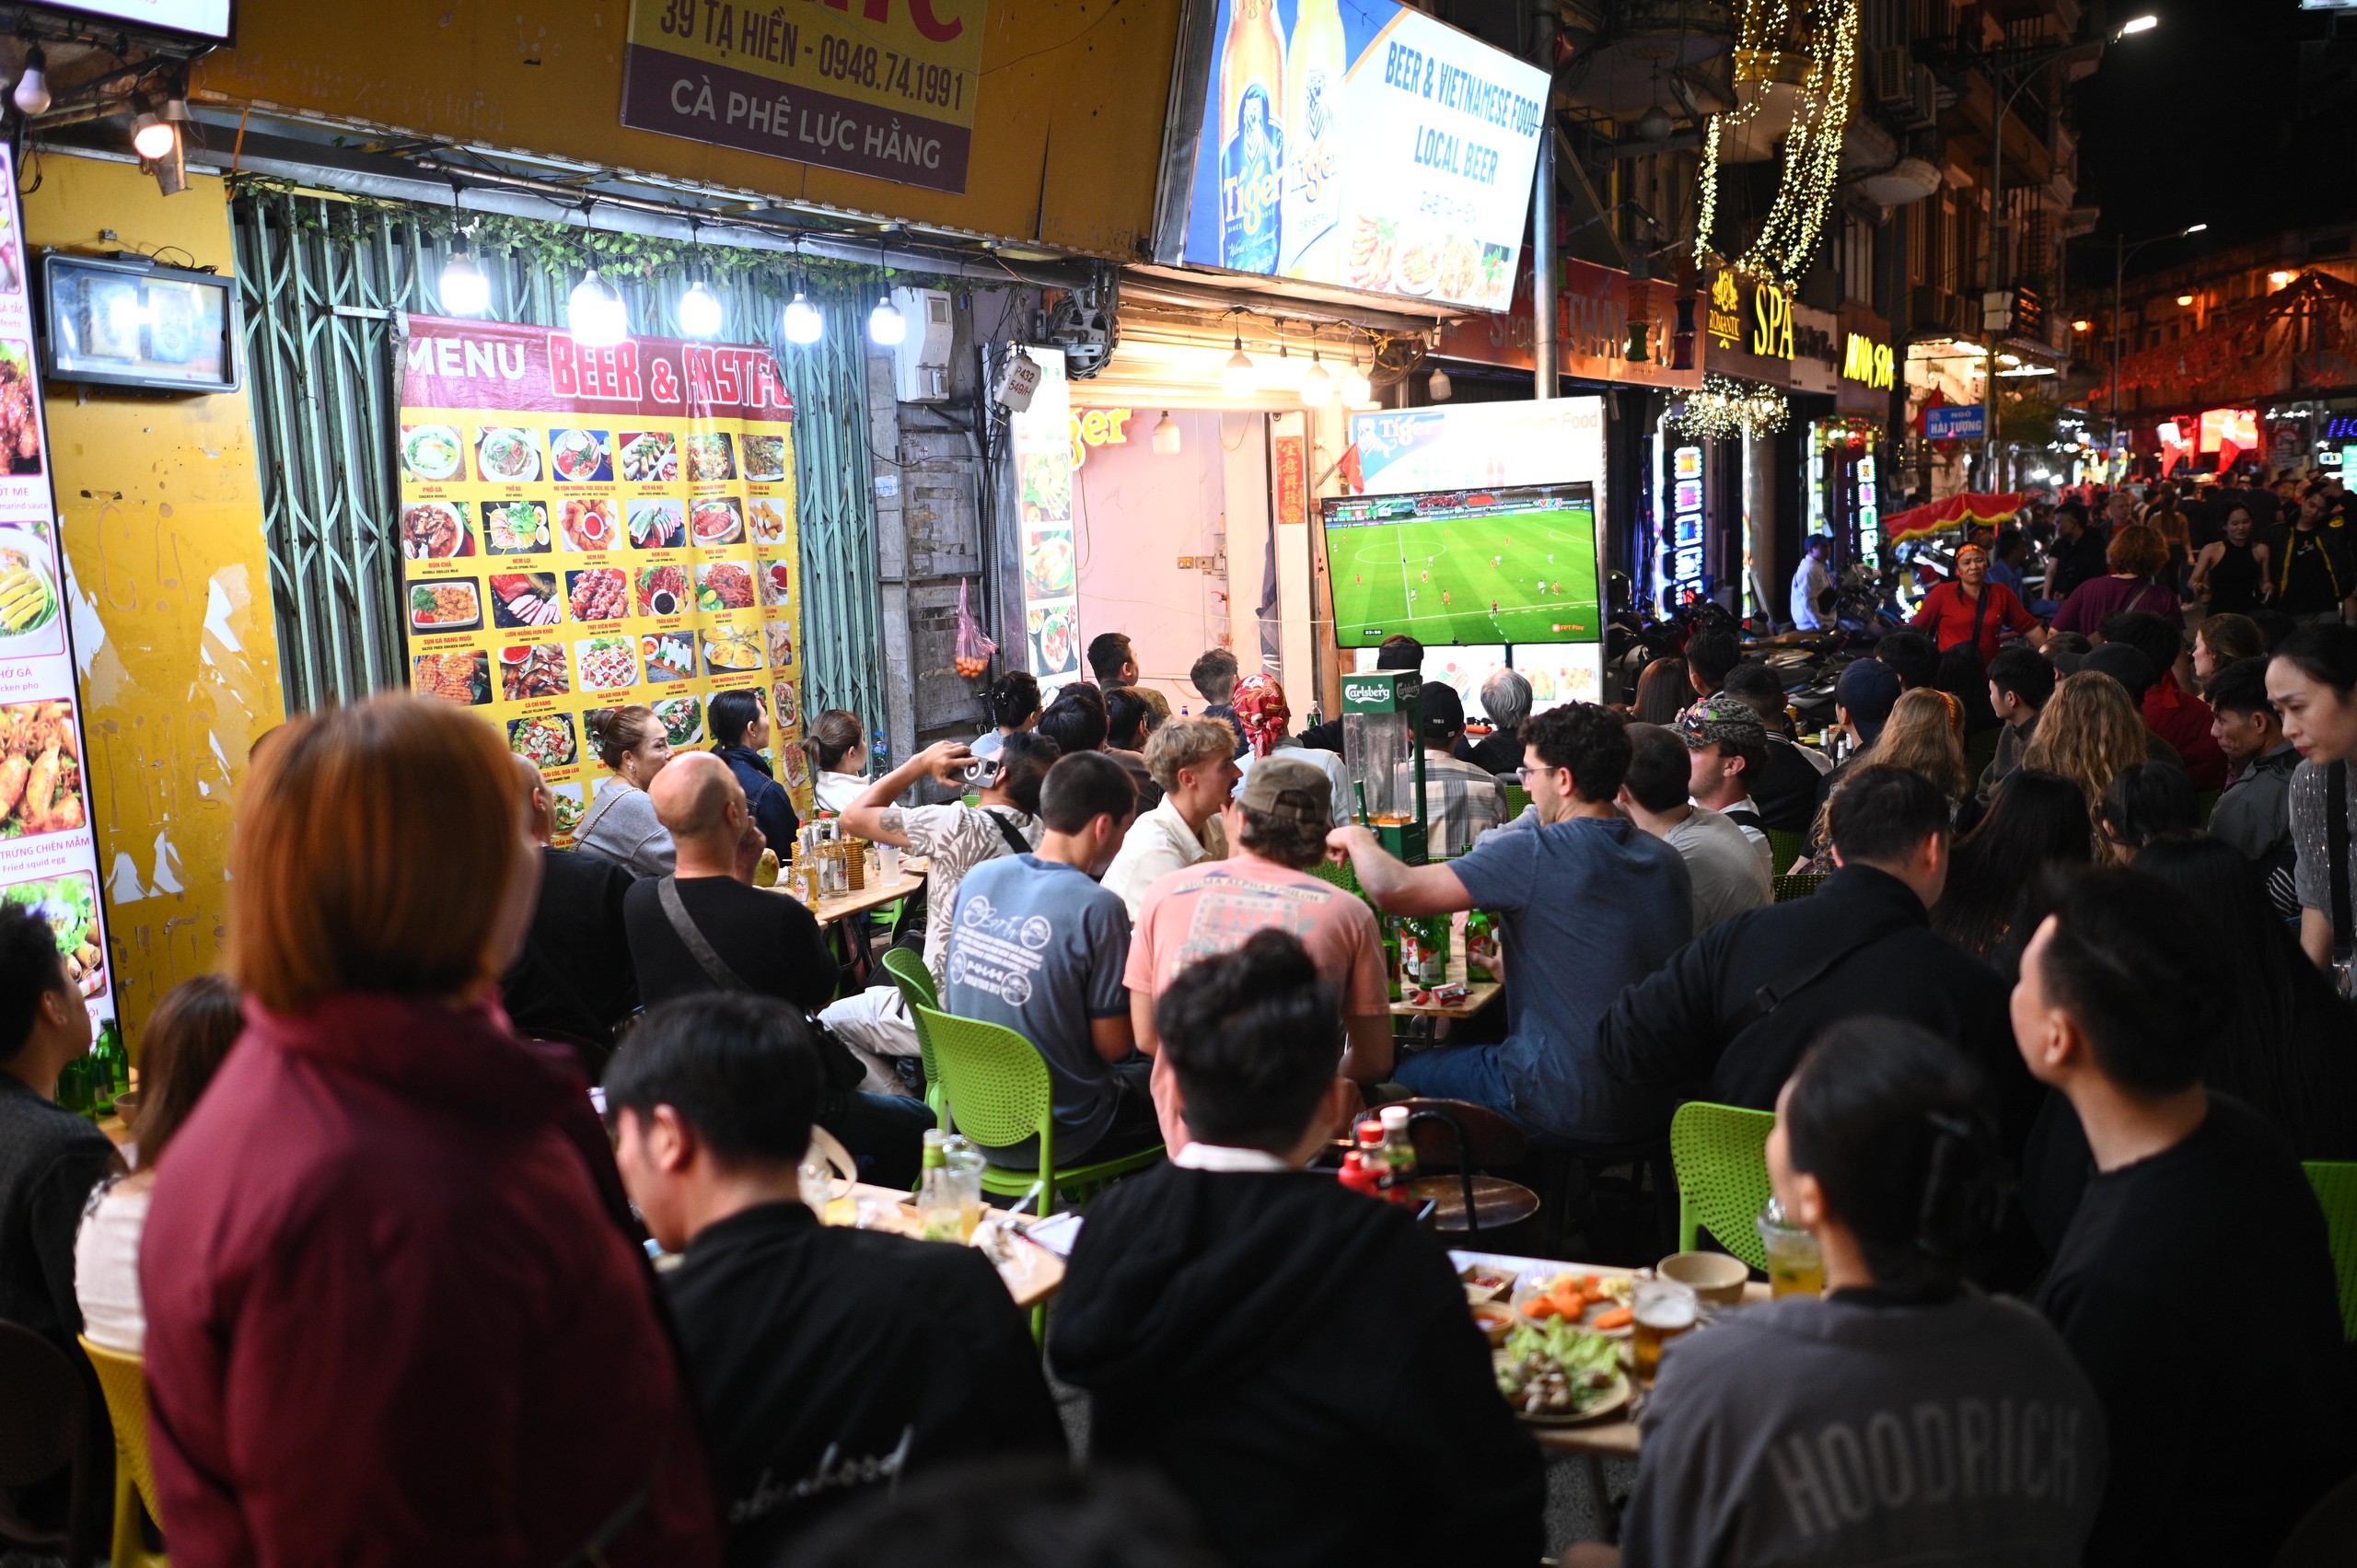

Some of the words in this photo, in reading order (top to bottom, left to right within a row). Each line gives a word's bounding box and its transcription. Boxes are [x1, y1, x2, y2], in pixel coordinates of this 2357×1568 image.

[704, 0, 733, 58] TẠ
[740, 7, 799, 68] HIỀN
[819, 34, 962, 110] 0948.74.1991
[1385, 41, 1422, 95] BEER
[1422, 57, 1434, 99] &
[1438, 63, 1512, 128] VIETNAMESE
[1510, 94, 1538, 138] FOOD
[670, 75, 715, 121] CÀ
[726, 96, 790, 137] PHÊ
[798, 110, 857, 155] LỰC
[864, 118, 941, 169] HẰNG
[1414, 125, 1460, 175] LOCAL
[1463, 142, 1498, 185] BEER
[1223, 158, 1283, 234] Tiger
[1709, 309, 1740, 336] ROMANTIC
[1754, 283, 1794, 360] SPA
[408, 337, 526, 380] MENU
[548, 332, 643, 401] BEER
[651, 358, 680, 403] &
[1014, 366, 1035, 384] P432
[1379, 415, 1434, 446] Tiger
[1562, 412, 1597, 429] Food
[13, 488, 29, 497] ME
[1572, 623, 1585, 633] Play
[17, 666, 33, 679] GÀ
[22, 681, 40, 692] pho
[1344, 683, 1390, 704] Carlsberg
[1396, 679, 1421, 701] Carlsberg
[0, 842, 34, 861] TRỨNG
[36, 841, 64, 855] CHIÊN
[2, 862, 25, 873] Fried
[27, 857, 50, 872] squid
[51, 855, 66, 866] egg
[1226, 877, 1265, 891] ALPHA
[1268, 884, 1318, 901] EPSILON
[1767, 1397, 2083, 1536] HOODRICH
